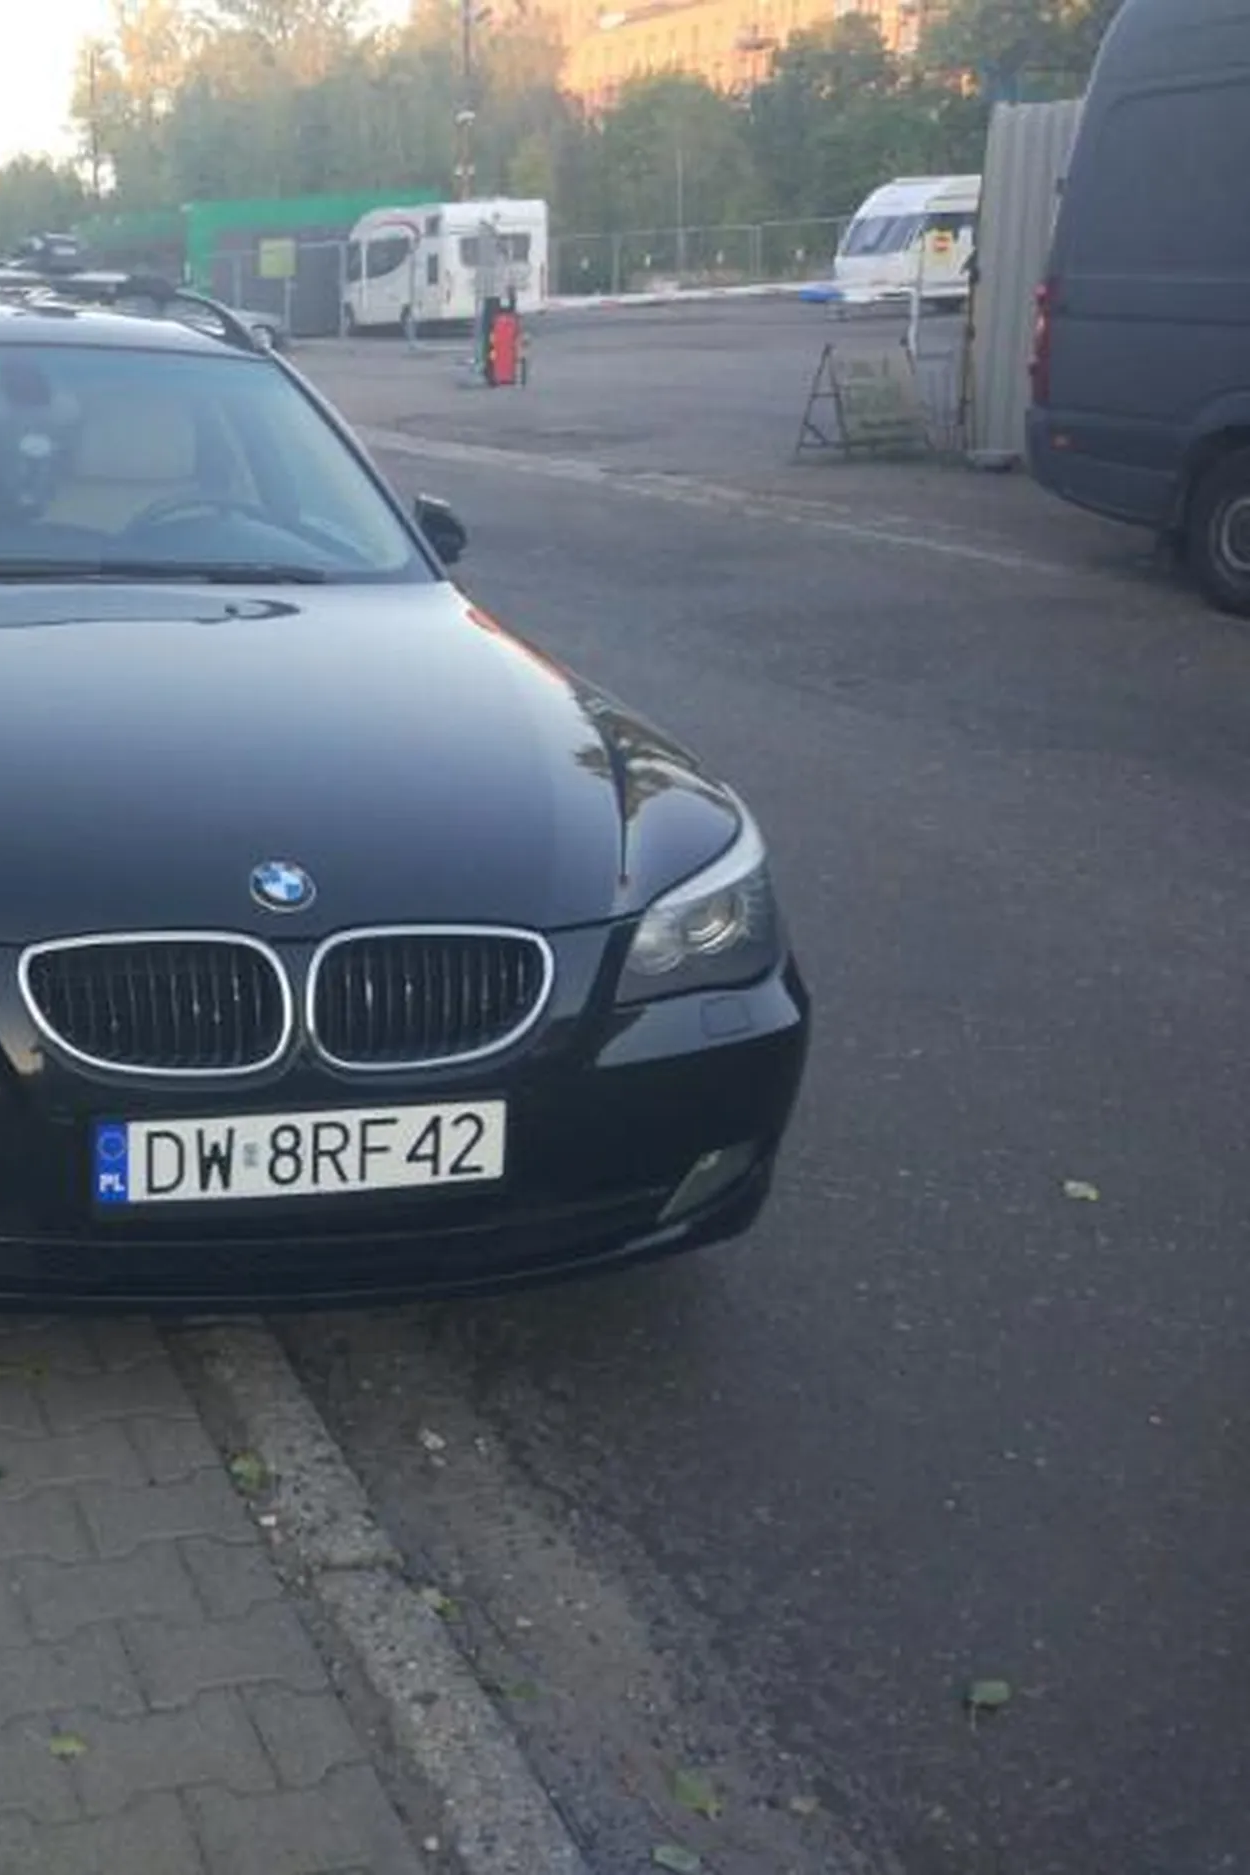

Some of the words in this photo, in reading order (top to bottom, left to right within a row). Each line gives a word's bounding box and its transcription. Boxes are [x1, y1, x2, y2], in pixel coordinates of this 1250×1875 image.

[146, 1126, 235, 1194] DW
[268, 1112, 485, 1186] 8RF42
[99, 1173, 125, 1193] PL
